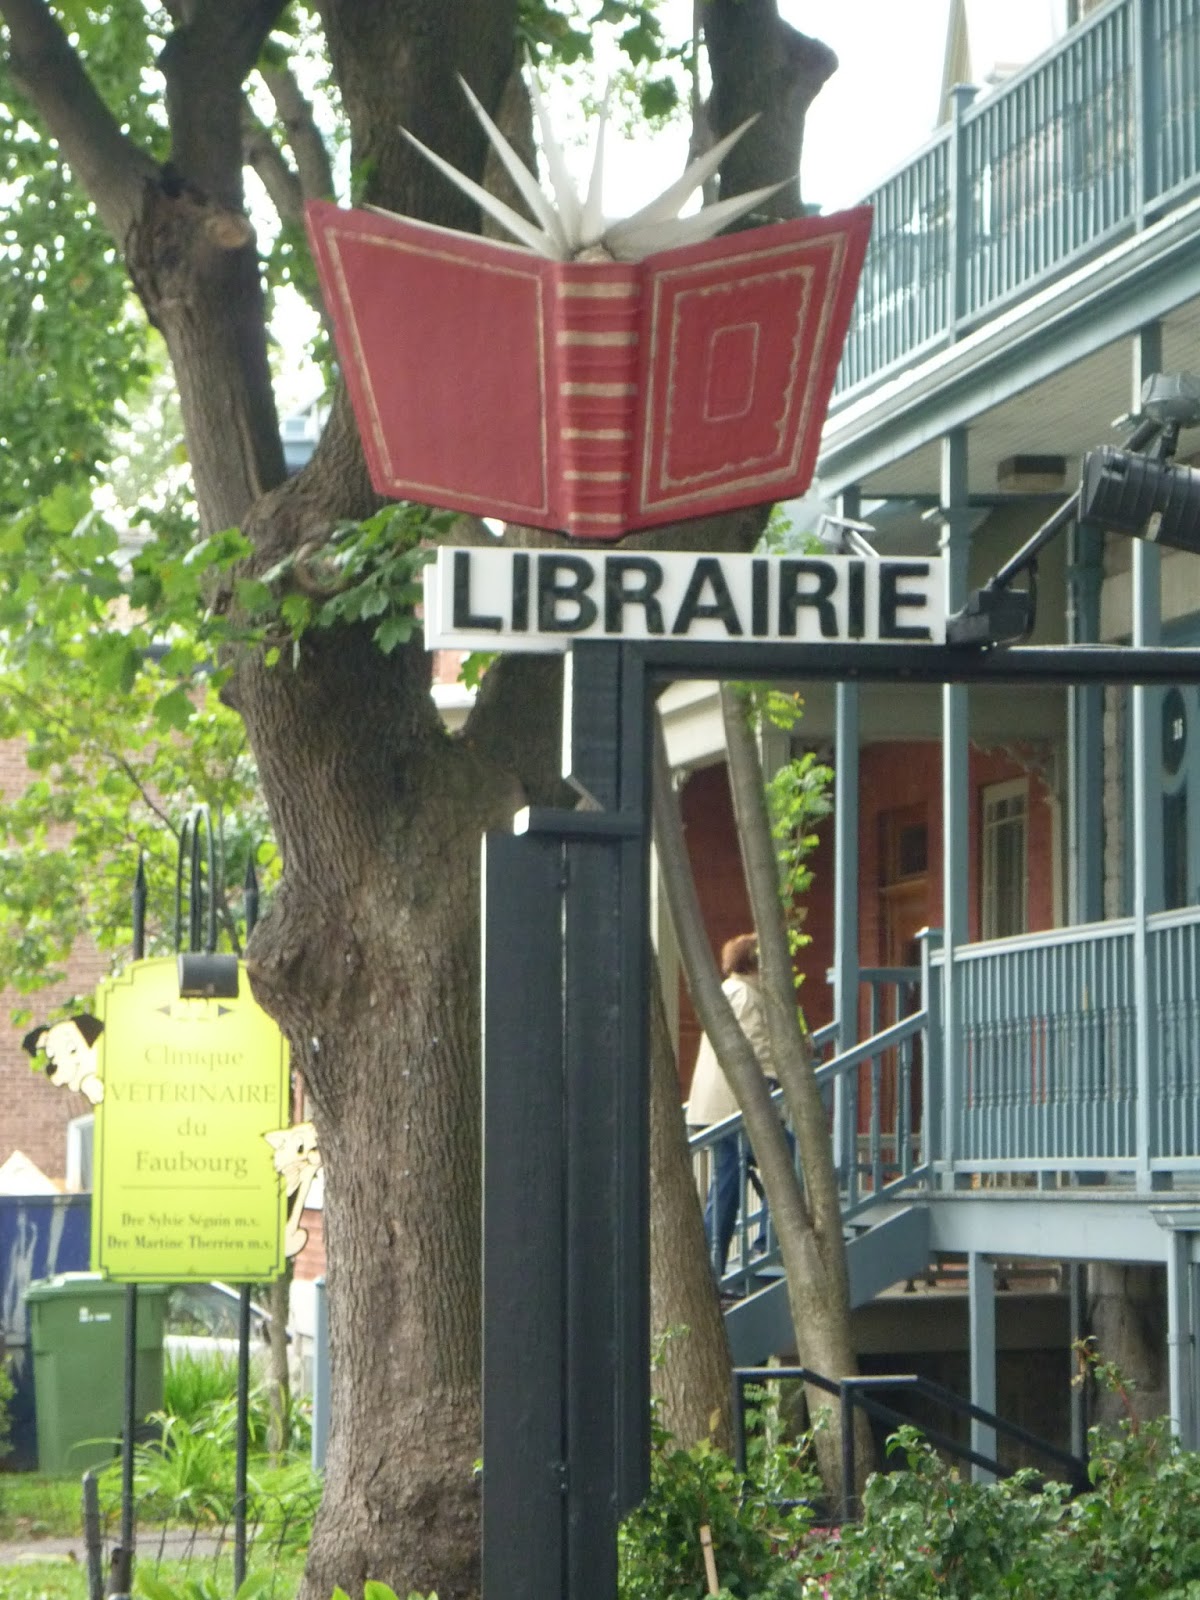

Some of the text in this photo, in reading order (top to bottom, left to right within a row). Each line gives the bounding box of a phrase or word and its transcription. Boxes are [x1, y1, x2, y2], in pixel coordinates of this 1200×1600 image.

[452, 551, 931, 641] LIBRAIRIE
[144, 1046, 244, 1071] Clinique
[177, 1117, 207, 1136] du
[136, 1151, 248, 1178] Faubourg
